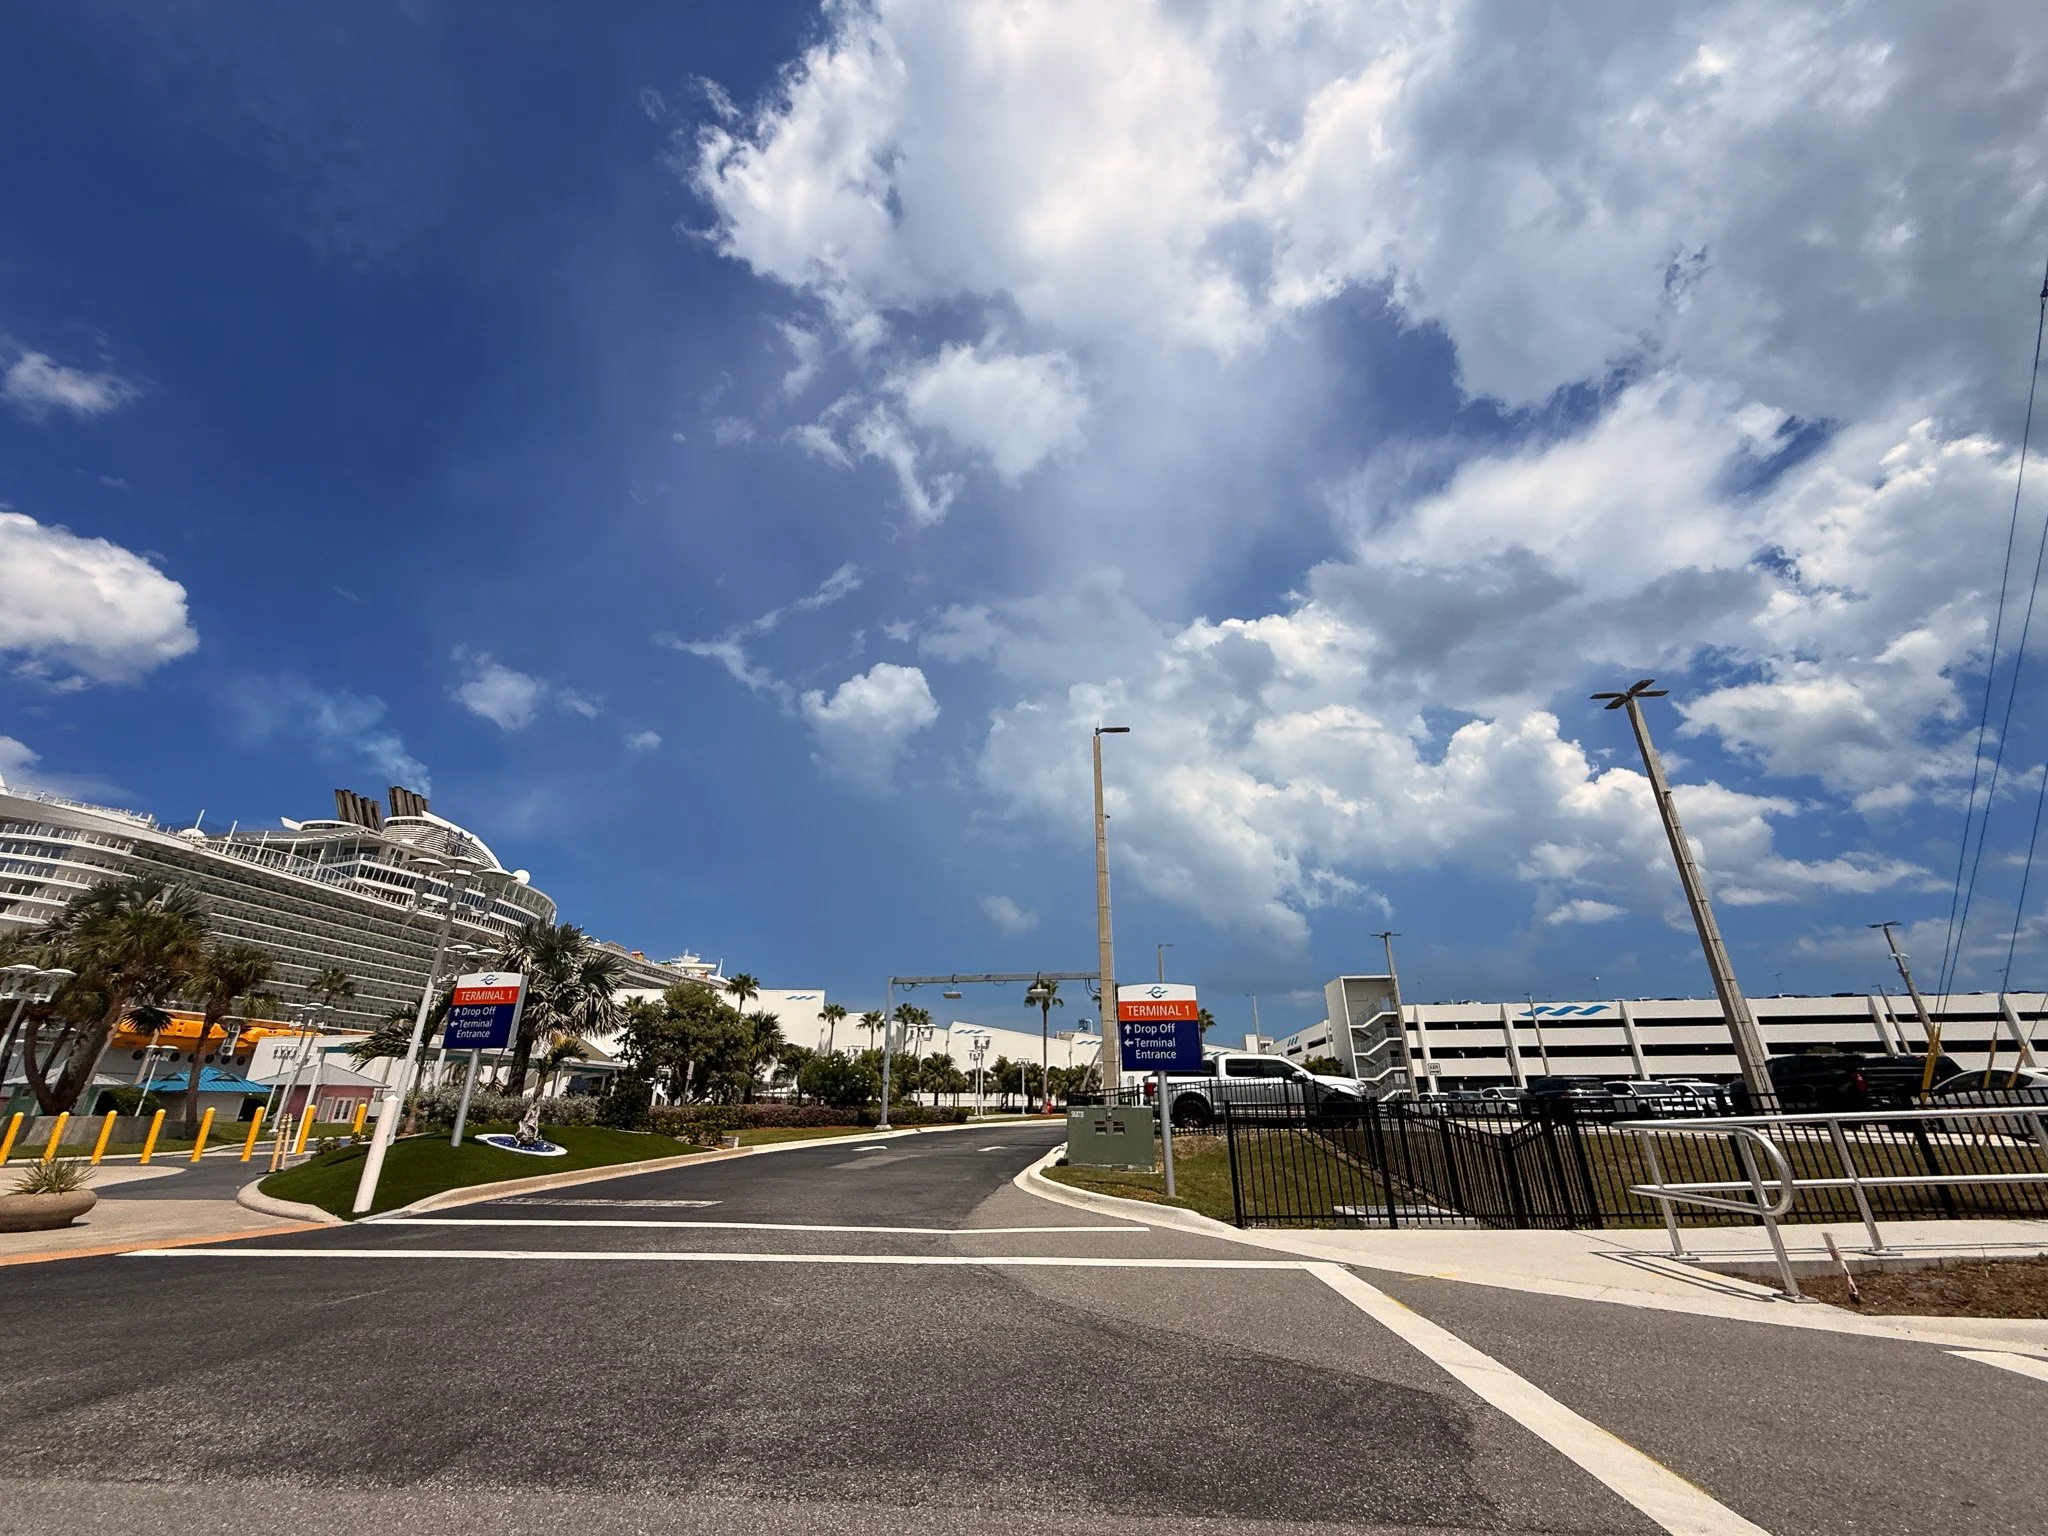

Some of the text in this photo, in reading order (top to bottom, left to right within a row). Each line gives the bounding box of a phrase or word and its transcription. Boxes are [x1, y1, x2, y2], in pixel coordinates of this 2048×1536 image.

[461, 990, 513, 1001] TERMINAL 1
[461, 1006, 497, 1017] Drop Off
[1126, 1005, 1190, 1017] TERMINAL 1
[459, 1019, 493, 1028] Terminal
[1134, 1023, 1176, 1035] Drop Off
[456, 1029, 491, 1039] Entrance
[1134, 1037, 1176, 1048] Terminal
[1135, 1049, 1177, 1059] Entrance
